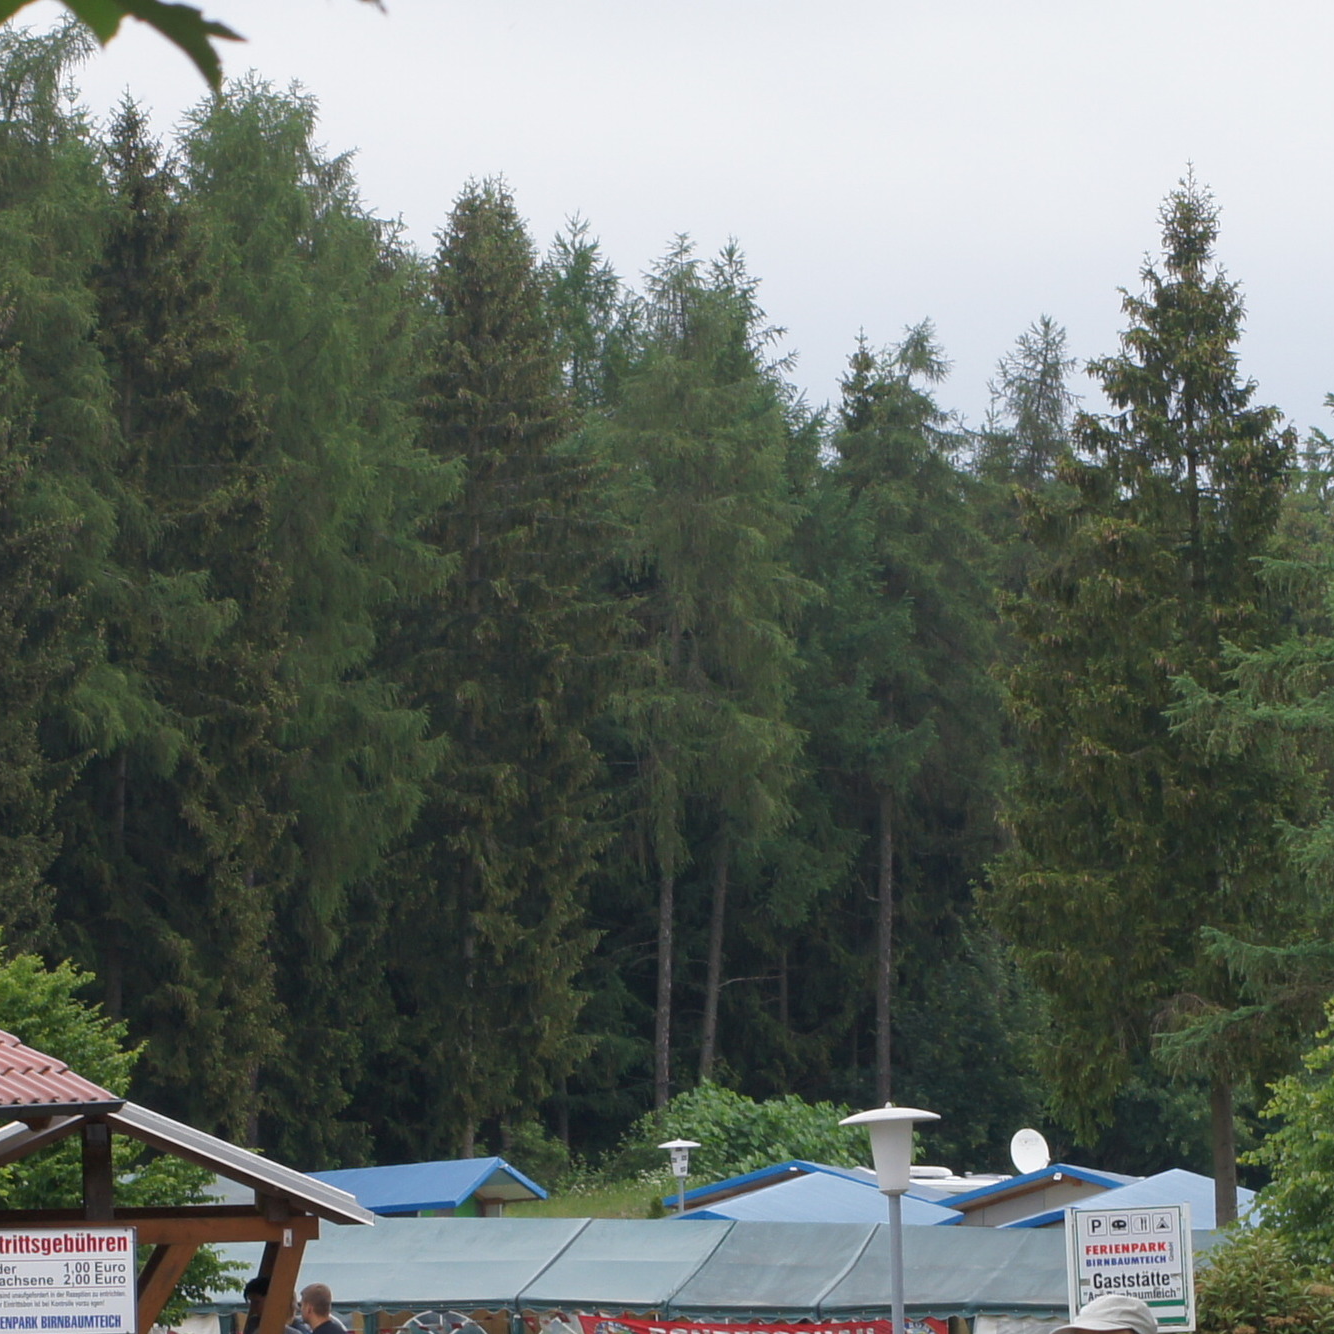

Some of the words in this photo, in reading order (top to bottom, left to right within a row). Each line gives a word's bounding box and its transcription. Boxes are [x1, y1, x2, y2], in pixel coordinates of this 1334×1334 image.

[1085, 1242, 1166, 1255] FERIENPARK
[1085, 1255, 1166, 1267] BIRNBAUMTEICH
[64, 1262, 90, 1275] 1,00
[95, 1262, 126, 1273] Euro
[64, 1274, 90, 1287] 2,00
[95, 1273, 126, 1284] Euro
[1093, 1270, 1171, 1289] Gaststätte
[41, 1315, 121, 1328] BIRNBAUMTEICH
